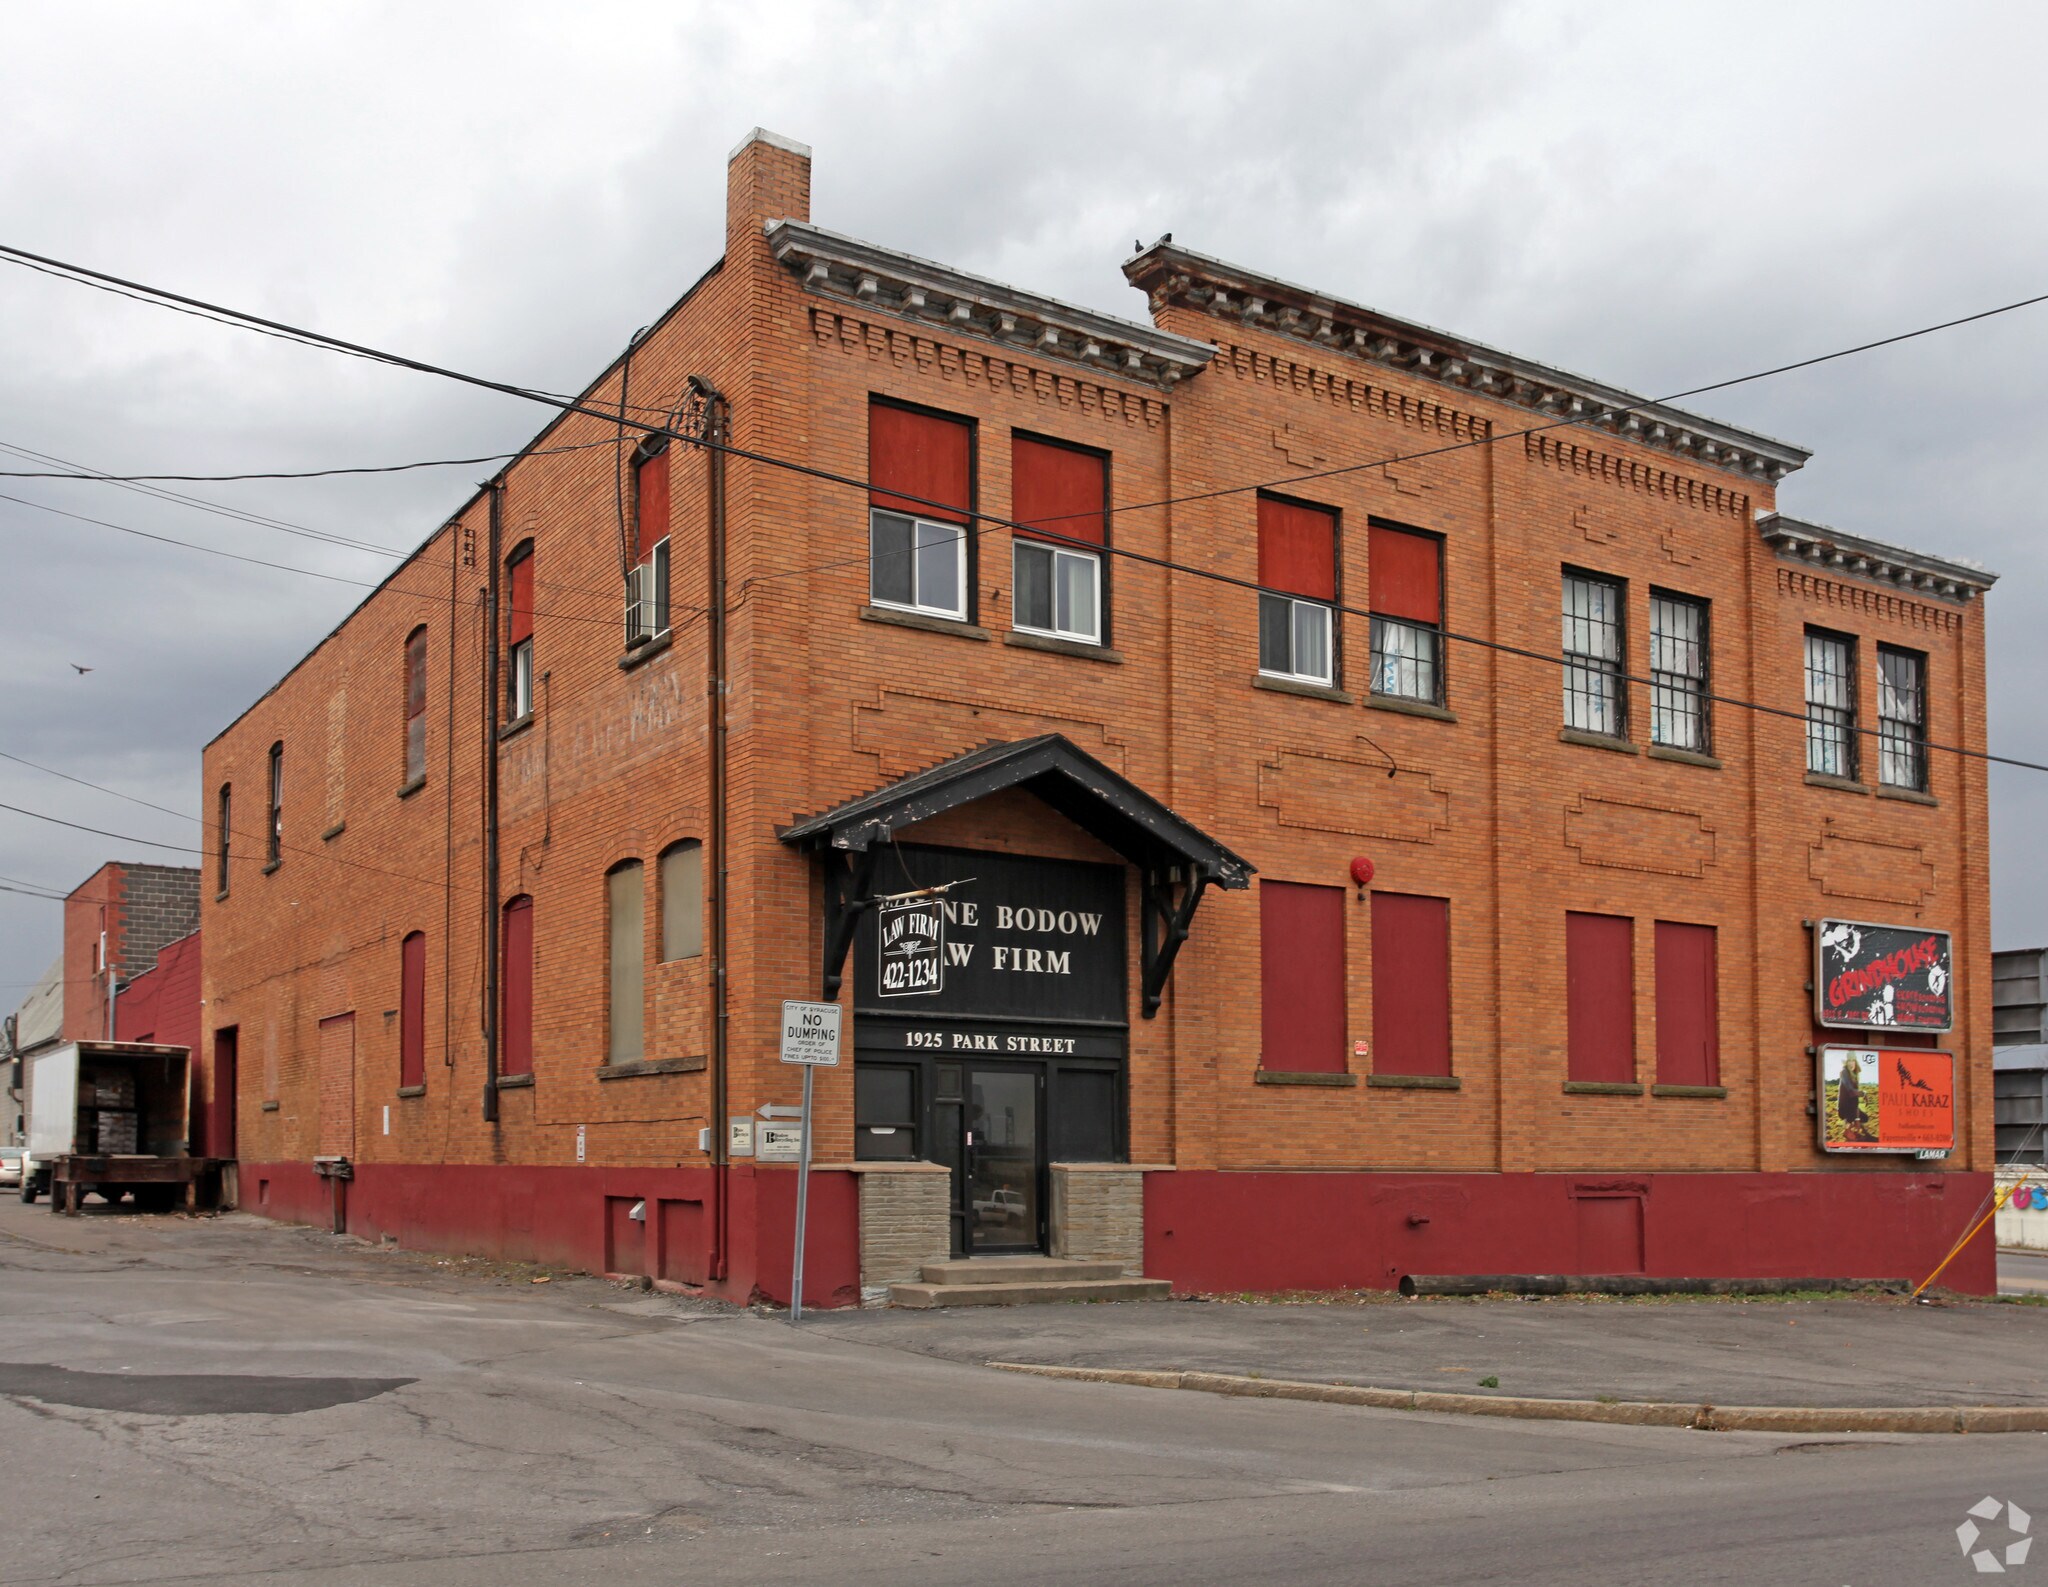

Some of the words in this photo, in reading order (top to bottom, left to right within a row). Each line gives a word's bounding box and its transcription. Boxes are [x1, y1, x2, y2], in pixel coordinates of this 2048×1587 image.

[883, 915, 905, 948] LAW
[909, 913, 940, 941] FIRM
[996, 905, 1103, 936] BODOW
[992, 946, 1071, 975] FIRM
[883, 958, 938, 990] 422-1234
[803, 1014, 822, 1026] NO
[788, 1026, 835, 1041] DUMPING
[906, 1032, 943, 1048] 1925
[952, 1033, 999, 1050] PARK
[1007, 1036, 1075, 1054] STREET
[1919, 1150, 1945, 1160] LAMAR
